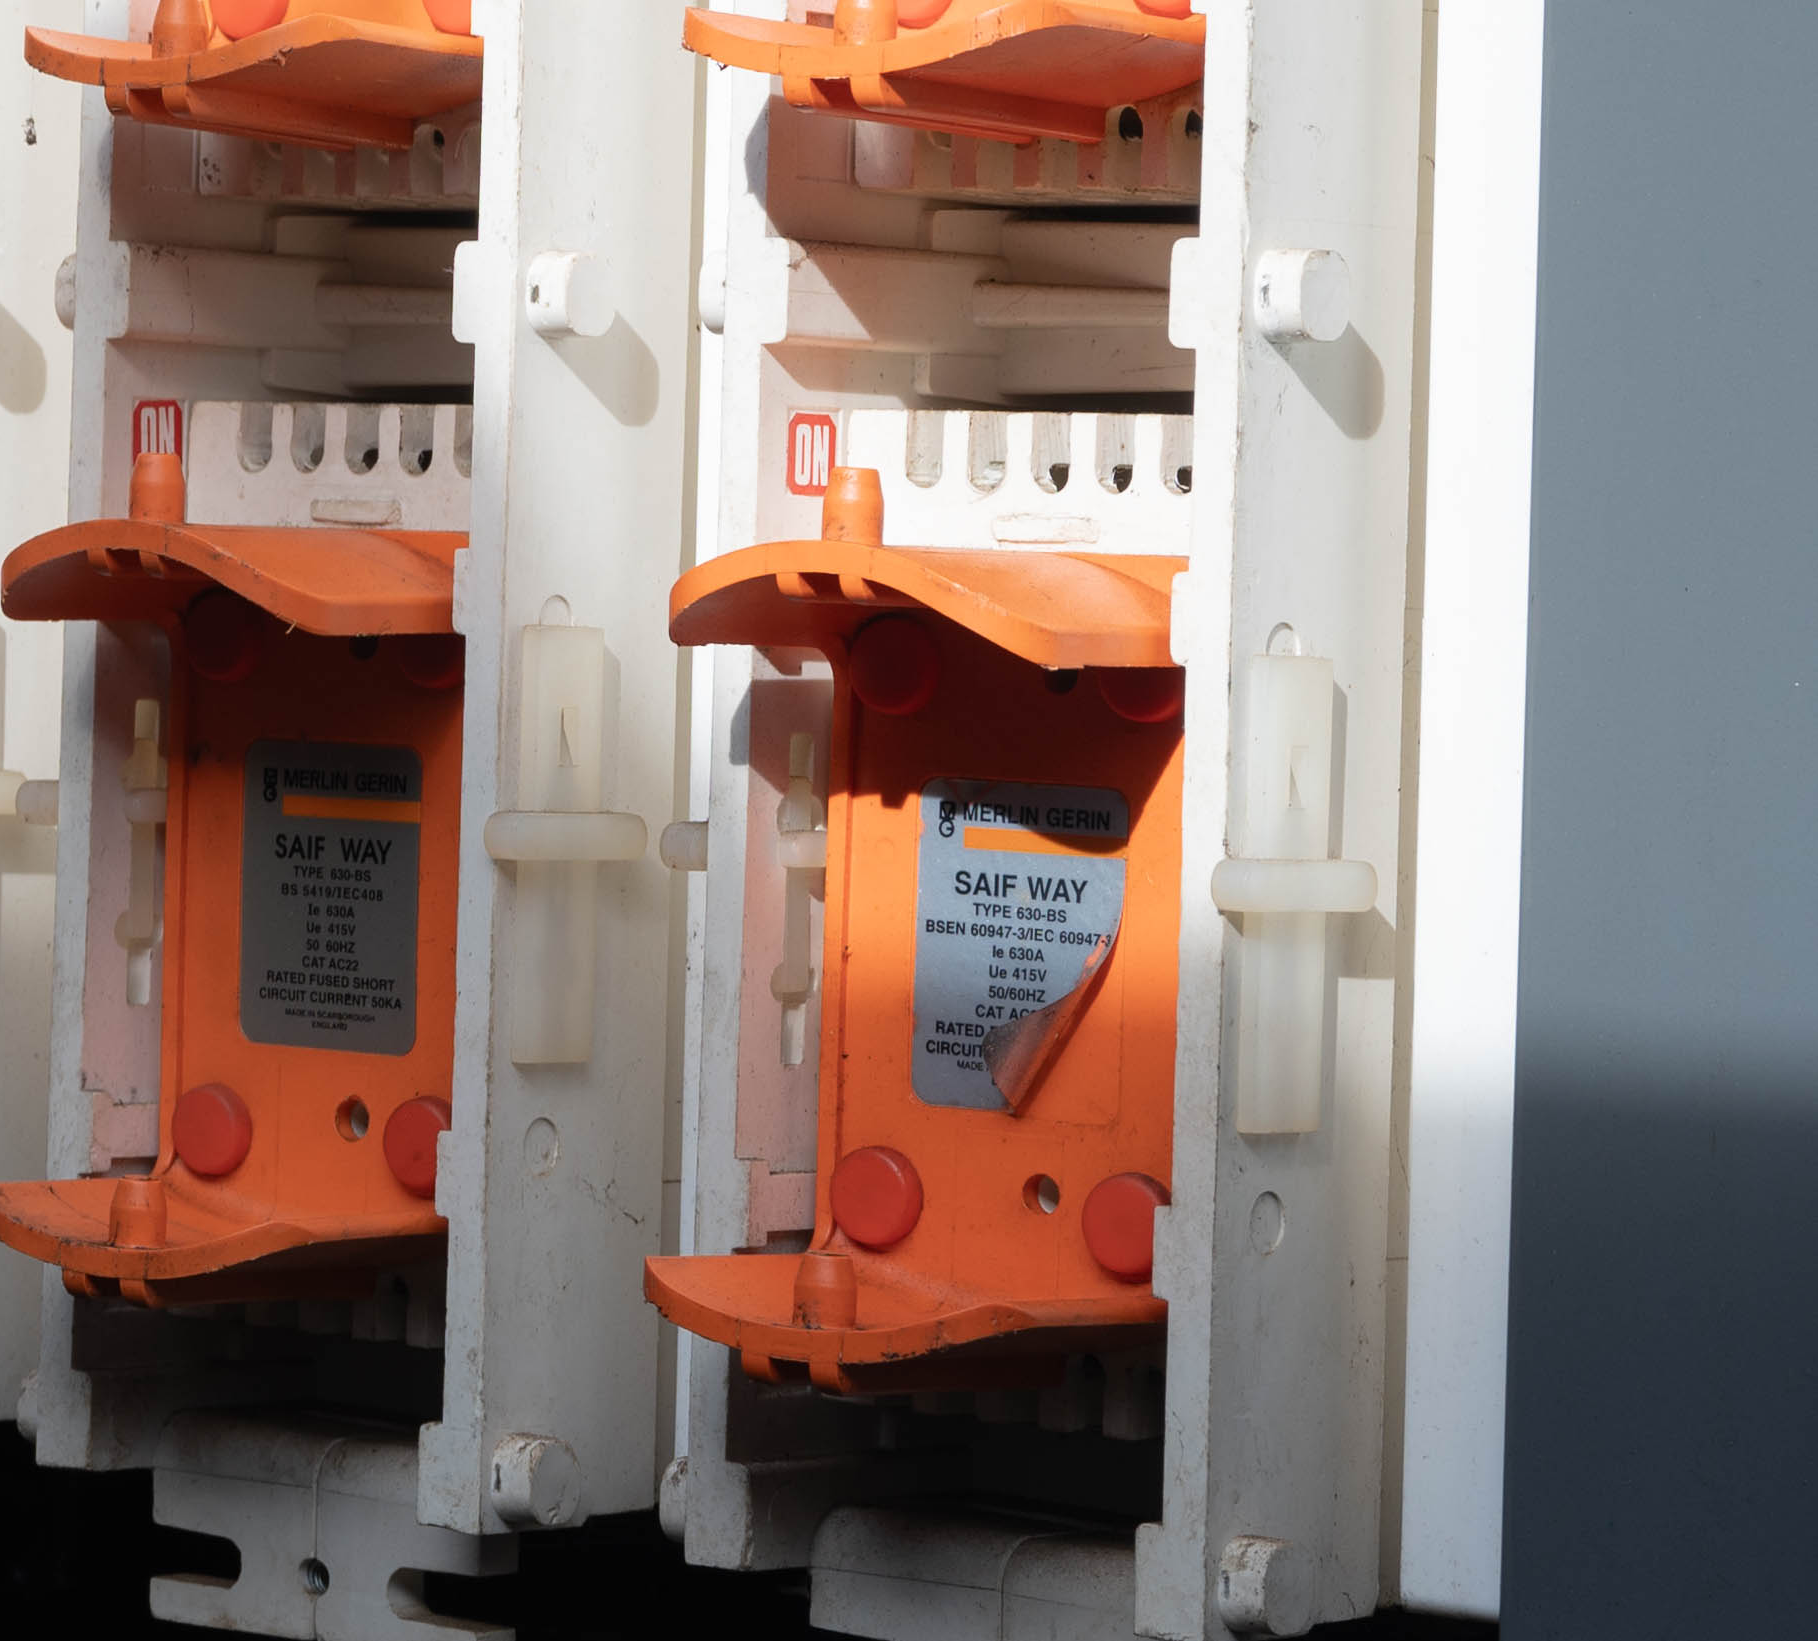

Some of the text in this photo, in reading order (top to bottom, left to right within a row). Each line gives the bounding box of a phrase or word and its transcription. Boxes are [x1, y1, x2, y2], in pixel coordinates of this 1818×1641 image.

[140, 405, 175, 454] ON
[794, 423, 830, 486] ON
[283, 768, 407, 794] MERLIN GERIN
[963, 801, 1110, 830] MERLIN GERIN
[274, 833, 391, 864] SAIF WAY
[293, 864, 371, 882] TYPE 630-BS
[281, 882, 297, 895] BS
[954, 870, 1087, 903] SAIF WAY
[972, 902, 1066, 923] TYPE 630-BS
[306, 920, 355, 936] Ue 415V
[925, 919, 965, 935] BSEN
[970, 923, 1053, 942] 60947-3/IEC
[301, 955, 358, 971] CAT AC22
[992, 945, 1044, 962] Ie 630A
[266, 969, 395, 992] RATED FUSED SHORT
[989, 964, 1046, 982] Ue 415V
[259, 986, 401, 1010] CIRCUIT CURRENT 50KA
[988, 985, 1045, 1002] 50/60HZ
[975, 1004, 1004, 1019] CAT
[935, 1020, 984, 1037] RATED
[956, 1059, 983, 1071] MADE
